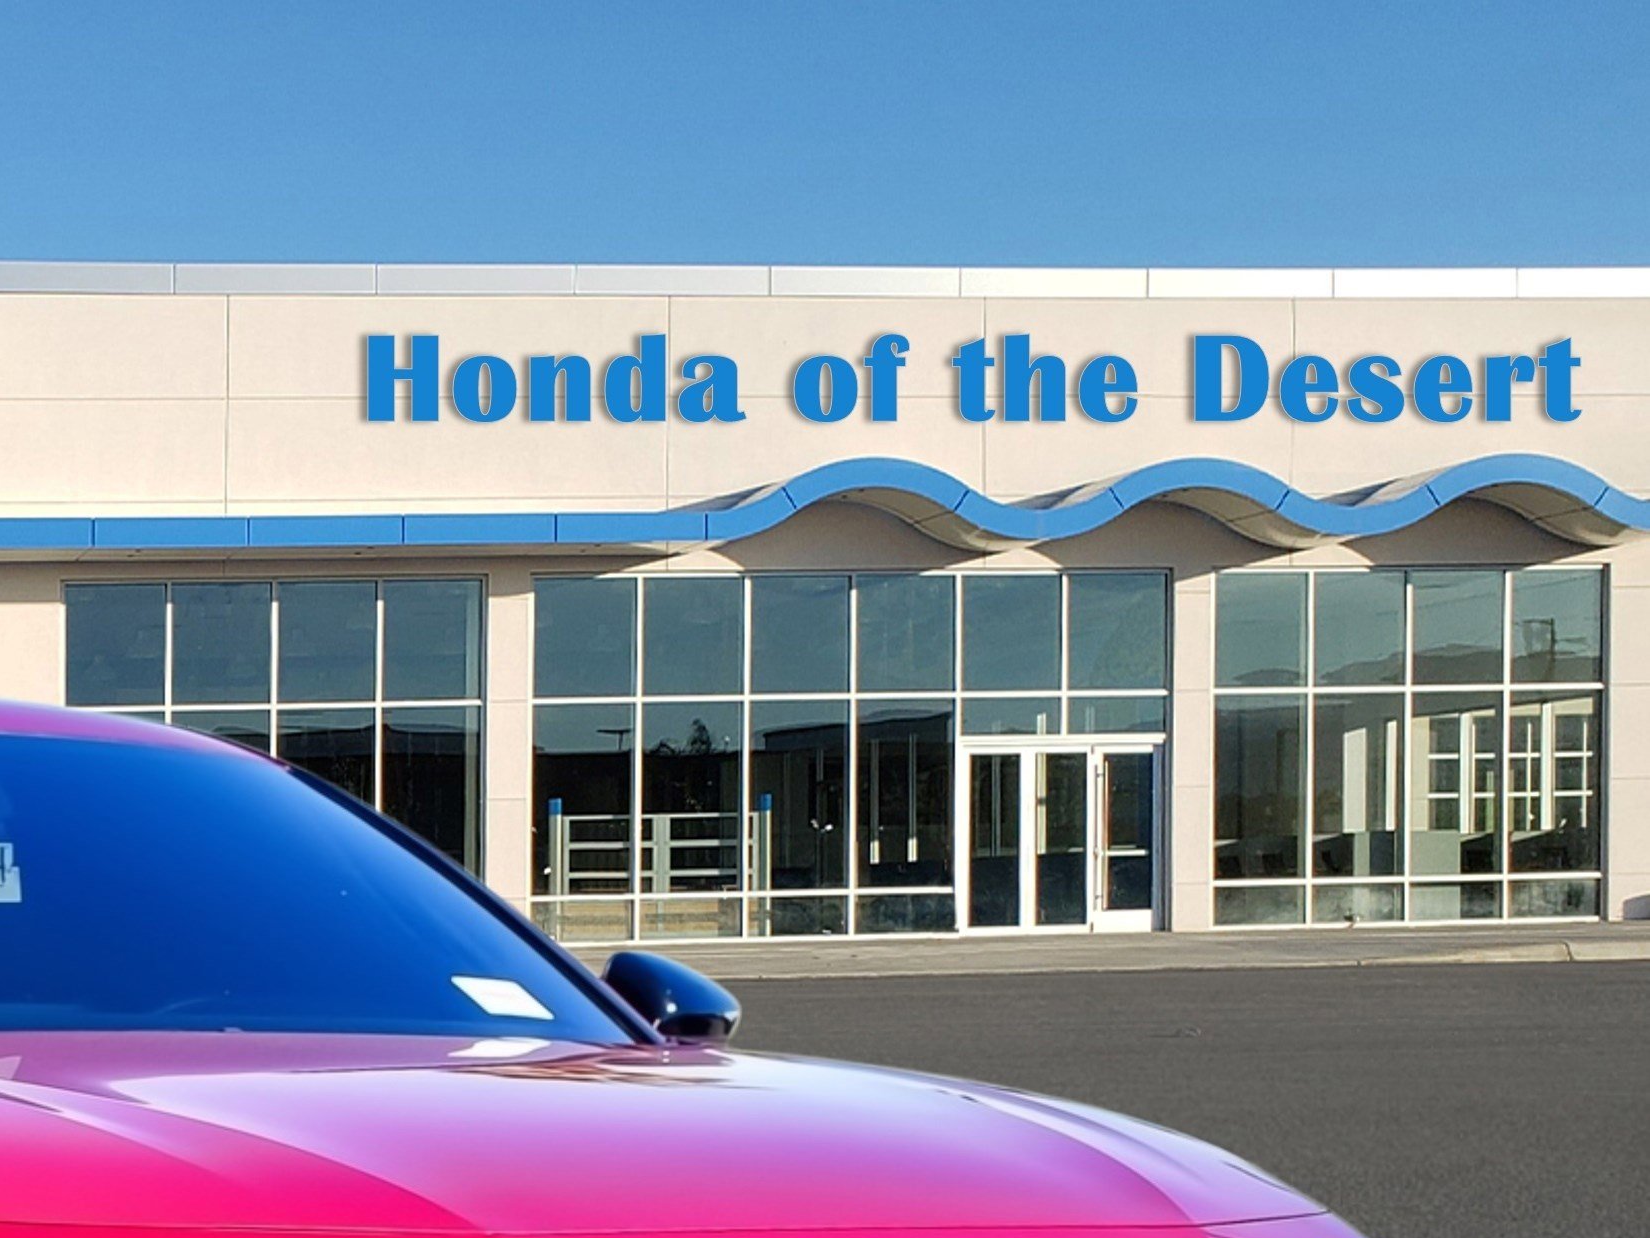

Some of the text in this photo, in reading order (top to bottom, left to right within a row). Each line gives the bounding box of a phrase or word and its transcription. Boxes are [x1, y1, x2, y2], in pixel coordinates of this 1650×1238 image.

[366, 334, 1582, 422] Honda of the Desert
